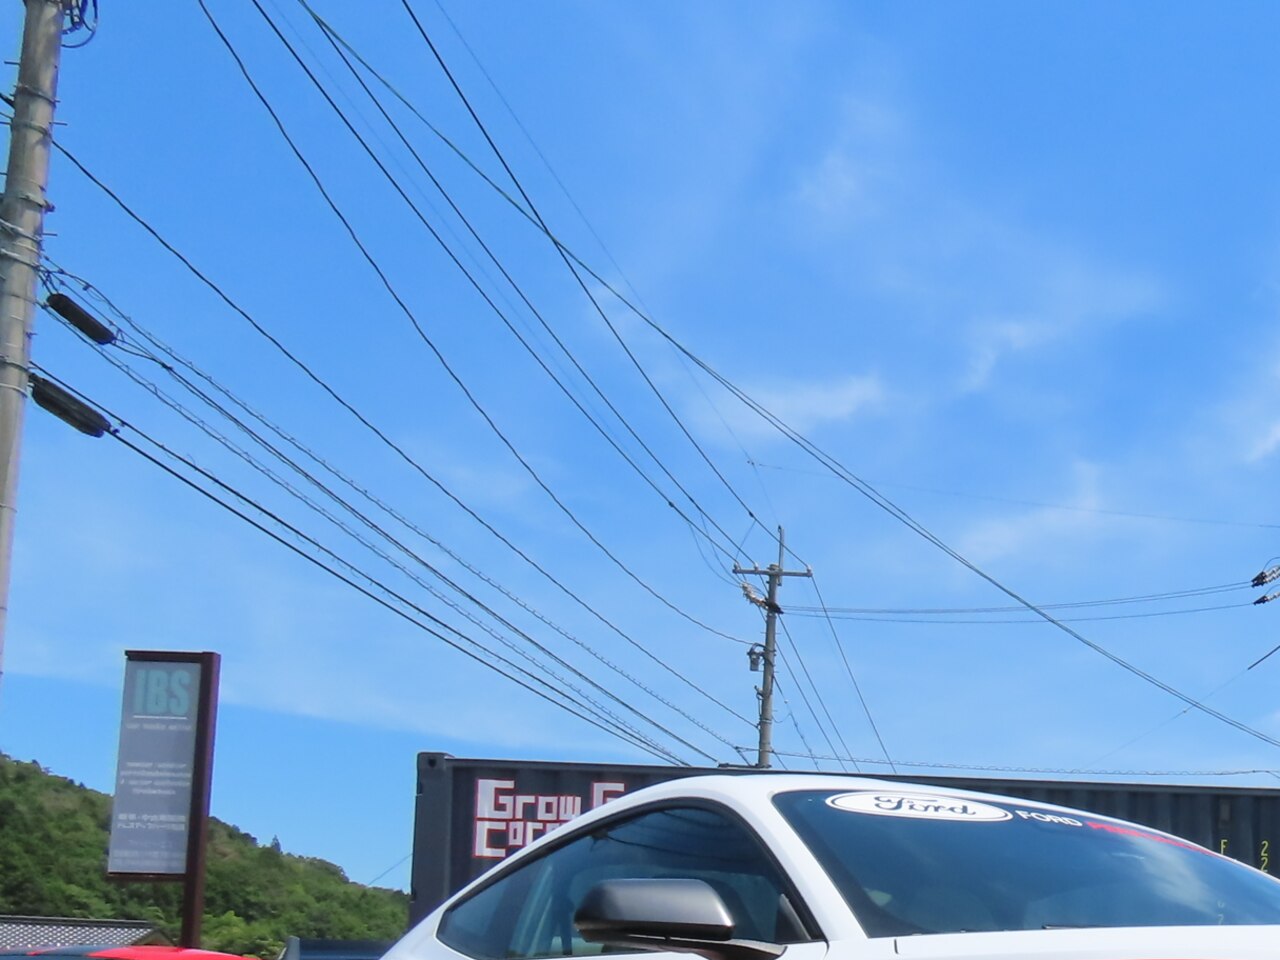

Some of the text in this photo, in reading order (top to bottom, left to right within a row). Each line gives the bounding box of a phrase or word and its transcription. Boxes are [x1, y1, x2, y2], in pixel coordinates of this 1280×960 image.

[133, 669, 192, 715] IBS
[474, 778, 582, 820] Grow
[873, 795, 978, 816] Ford
[1015, 809, 1084, 827] FORD
